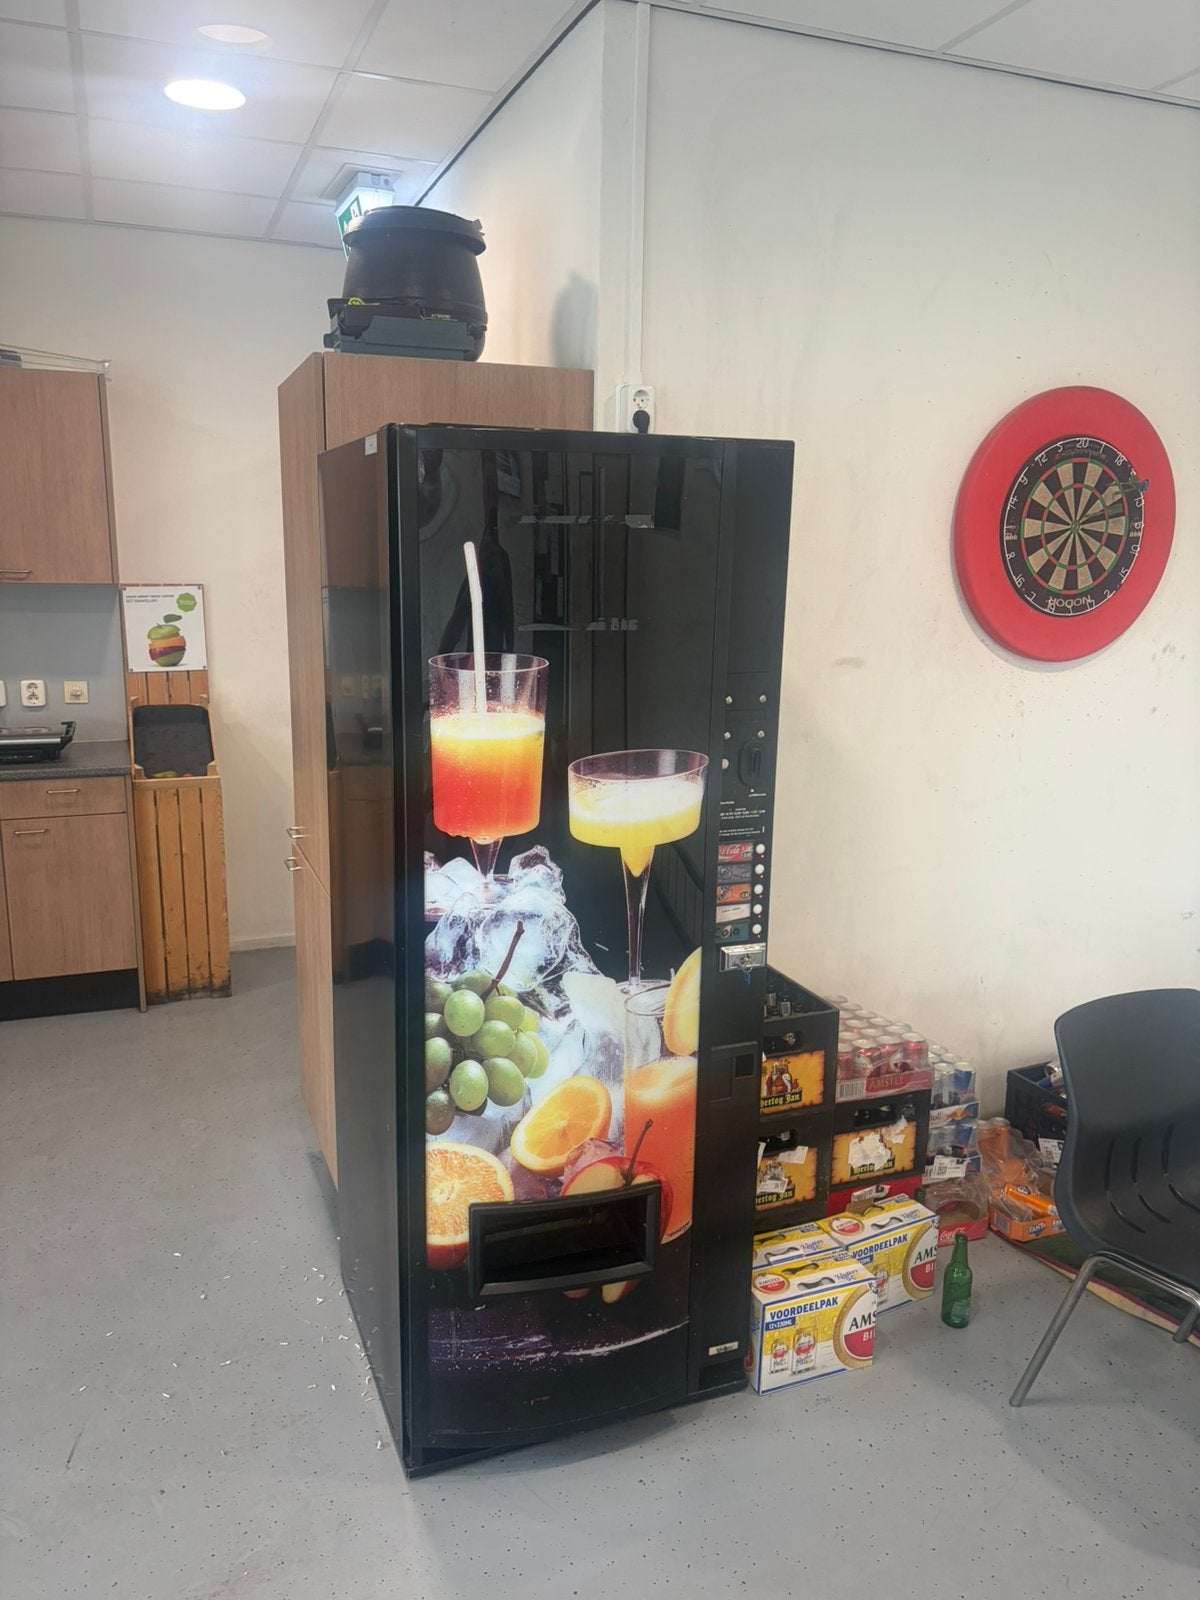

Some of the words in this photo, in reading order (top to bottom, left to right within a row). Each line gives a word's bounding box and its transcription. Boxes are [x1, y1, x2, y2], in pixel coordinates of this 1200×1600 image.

[1076, 438, 1089, 448] 20
[869, 1076, 903, 1092] AMSTEL
[852, 1232, 909, 1259] VOORDEELPAK
[769, 1295, 839, 1321] VOORDEELPAK
